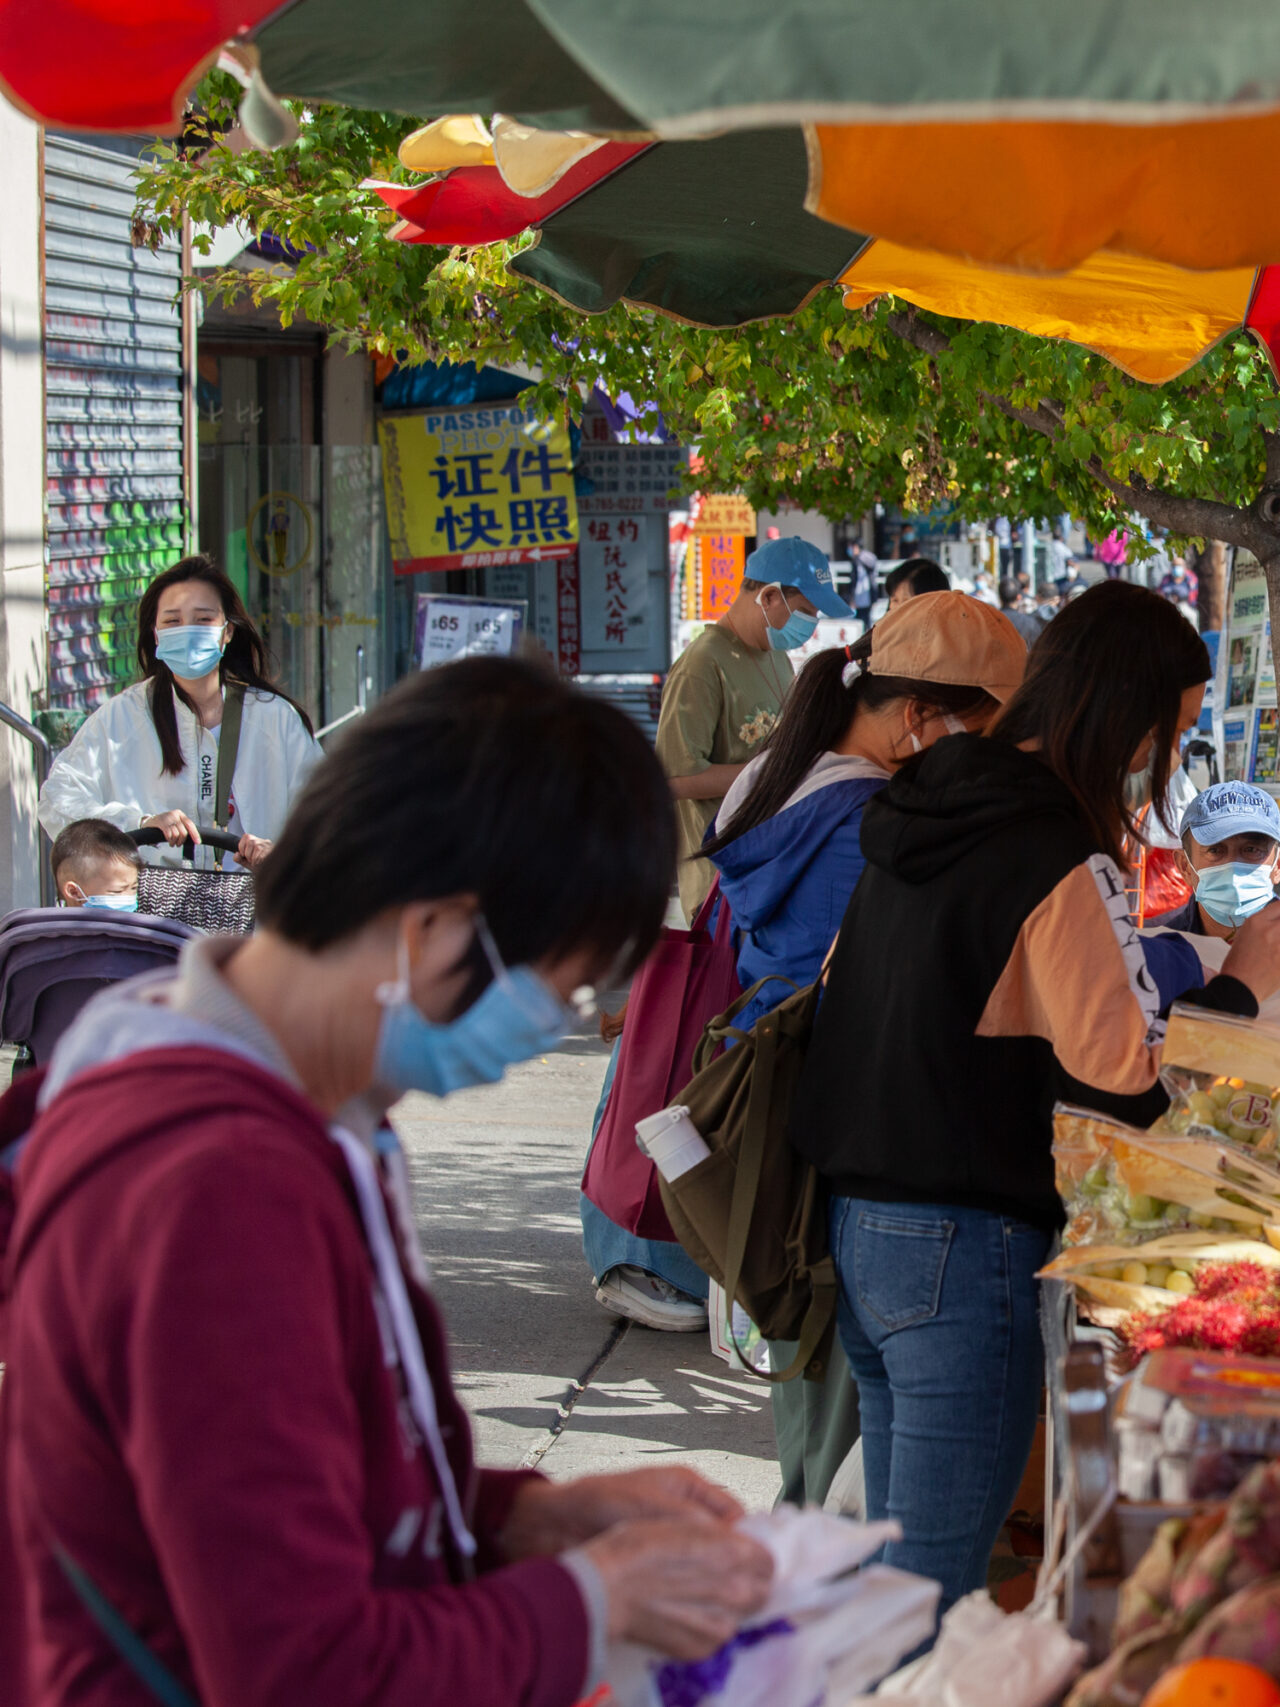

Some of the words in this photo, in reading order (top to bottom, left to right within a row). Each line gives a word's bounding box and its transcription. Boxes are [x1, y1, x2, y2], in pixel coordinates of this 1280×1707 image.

[439, 420, 552, 454] PHOTO
[429, 445, 568, 499] 证件
[434, 496, 575, 552] 快照
[431, 615, 459, 631] $65
[201, 755, 212, 800] CHANEL
[1208, 792, 1237, 813] NEW
